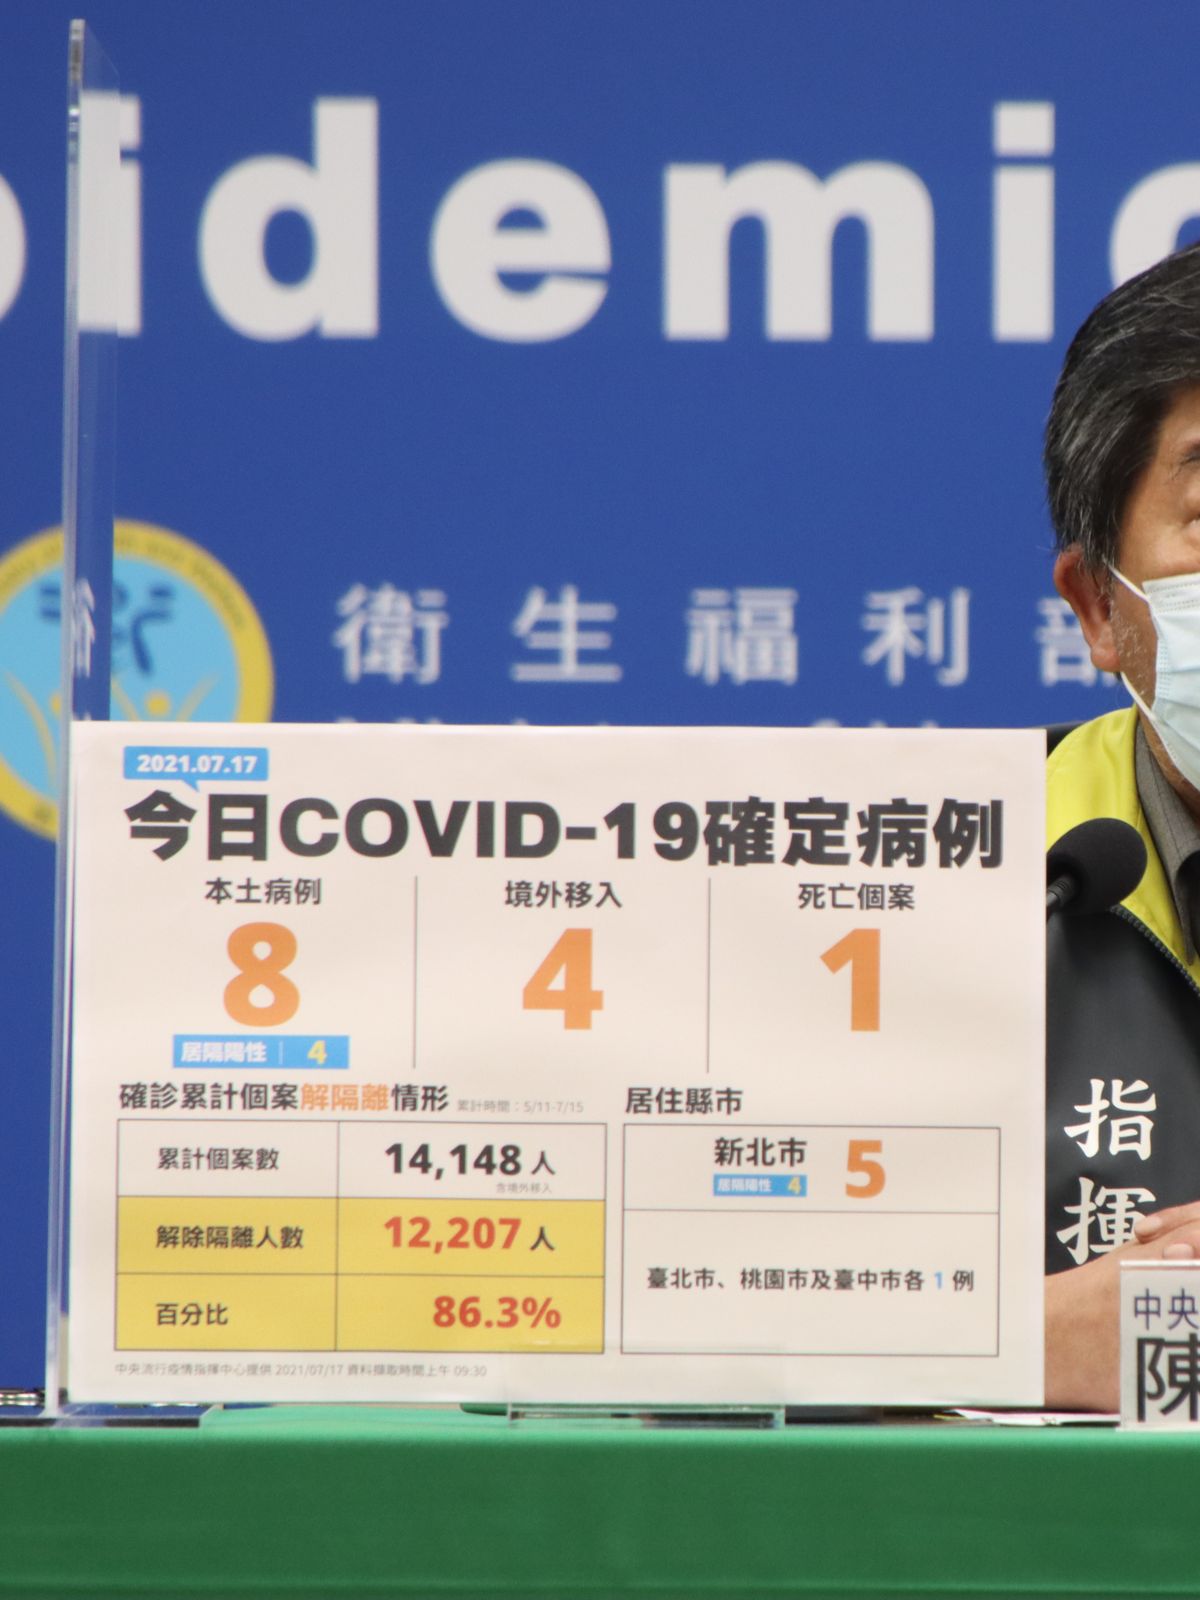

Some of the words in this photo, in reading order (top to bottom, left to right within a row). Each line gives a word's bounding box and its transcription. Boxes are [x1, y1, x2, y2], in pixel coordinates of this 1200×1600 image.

[136, 754, 258, 774] 2021.07.17
[124, 789, 1004, 869] 今日COVID-19確定病例
[205, 877, 322, 906] 本土病例
[505, 880, 623, 909] 境外移入
[798, 882, 915, 911] 死亡個案
[223, 922, 300, 1028] 8
[522, 928, 604, 1030] 4
[820, 928, 880, 1032] 1
[307, 1040, 328, 1065] 4
[625, 1087, 742, 1115] 居住縣市
[158, 1147, 280, 1171] 累計個案數
[714, 1137, 807, 1168] 新北市
[845, 1139, 887, 1200] 5
[155, 1225, 304, 1250] 解除隔離人數
[155, 1303, 229, 1327] 百分比
[433, 1295, 562, 1329] 86.3%
